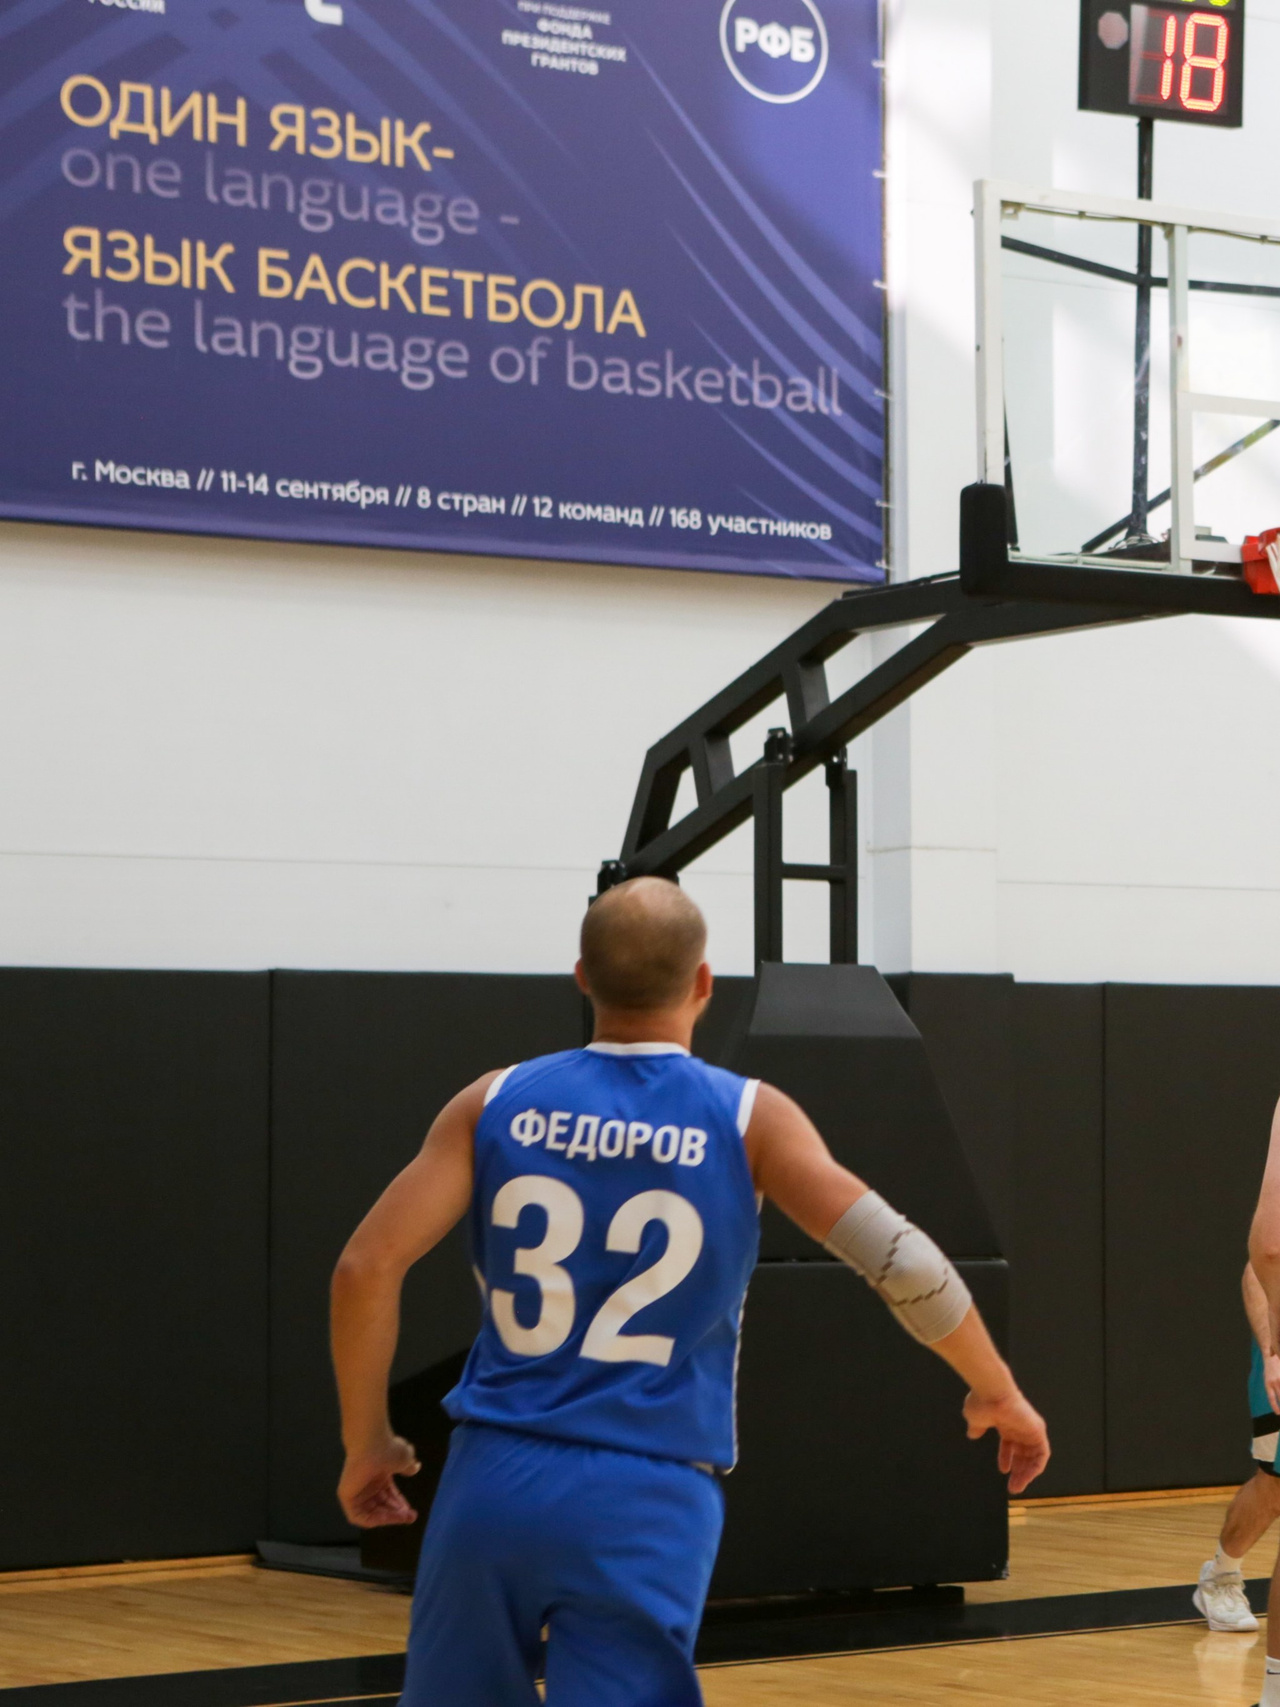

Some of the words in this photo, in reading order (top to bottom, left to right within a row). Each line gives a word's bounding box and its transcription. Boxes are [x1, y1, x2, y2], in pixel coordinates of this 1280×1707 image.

[501, 29, 627, 62] ПРЕЗИДЕНТСКИХ
[530, 52, 599, 75] ГРАНТОВ
[536, 18, 593, 40] ФОНДА
[735, 17, 816, 62] РФБ
[1160, 11, 1229, 112] 18
[60, 75, 248, 147] ОДИН
[269, 104, 455, 171] ЯЗЫК-
[61, 147, 182, 198] one
[205, 152, 480, 246] language
[62, 226, 235, 293] ЯЗЫК
[258, 247, 647, 337] БАСКЕТБОЛА
[63, 289, 171, 349] the
[194, 299, 470, 391] language
[489, 336, 553, 386] of
[565, 340, 844, 417] basketball
[72, 462, 87, 481] г.
[95, 459, 191, 489] Москва
[220, 471, 269, 496] 11-14
[275, 479, 390, 509] сентября
[417, 488, 432, 509] 8
[437, 492, 506, 517] стран
[533, 497, 553, 518] 12
[558, 503, 645, 527] команд
[669, 508, 702, 529] 168
[707, 514, 832, 541] участников
[510, 1108, 709, 1168] ФЕДОРОВ
[490, 1175, 705, 1367] 32
